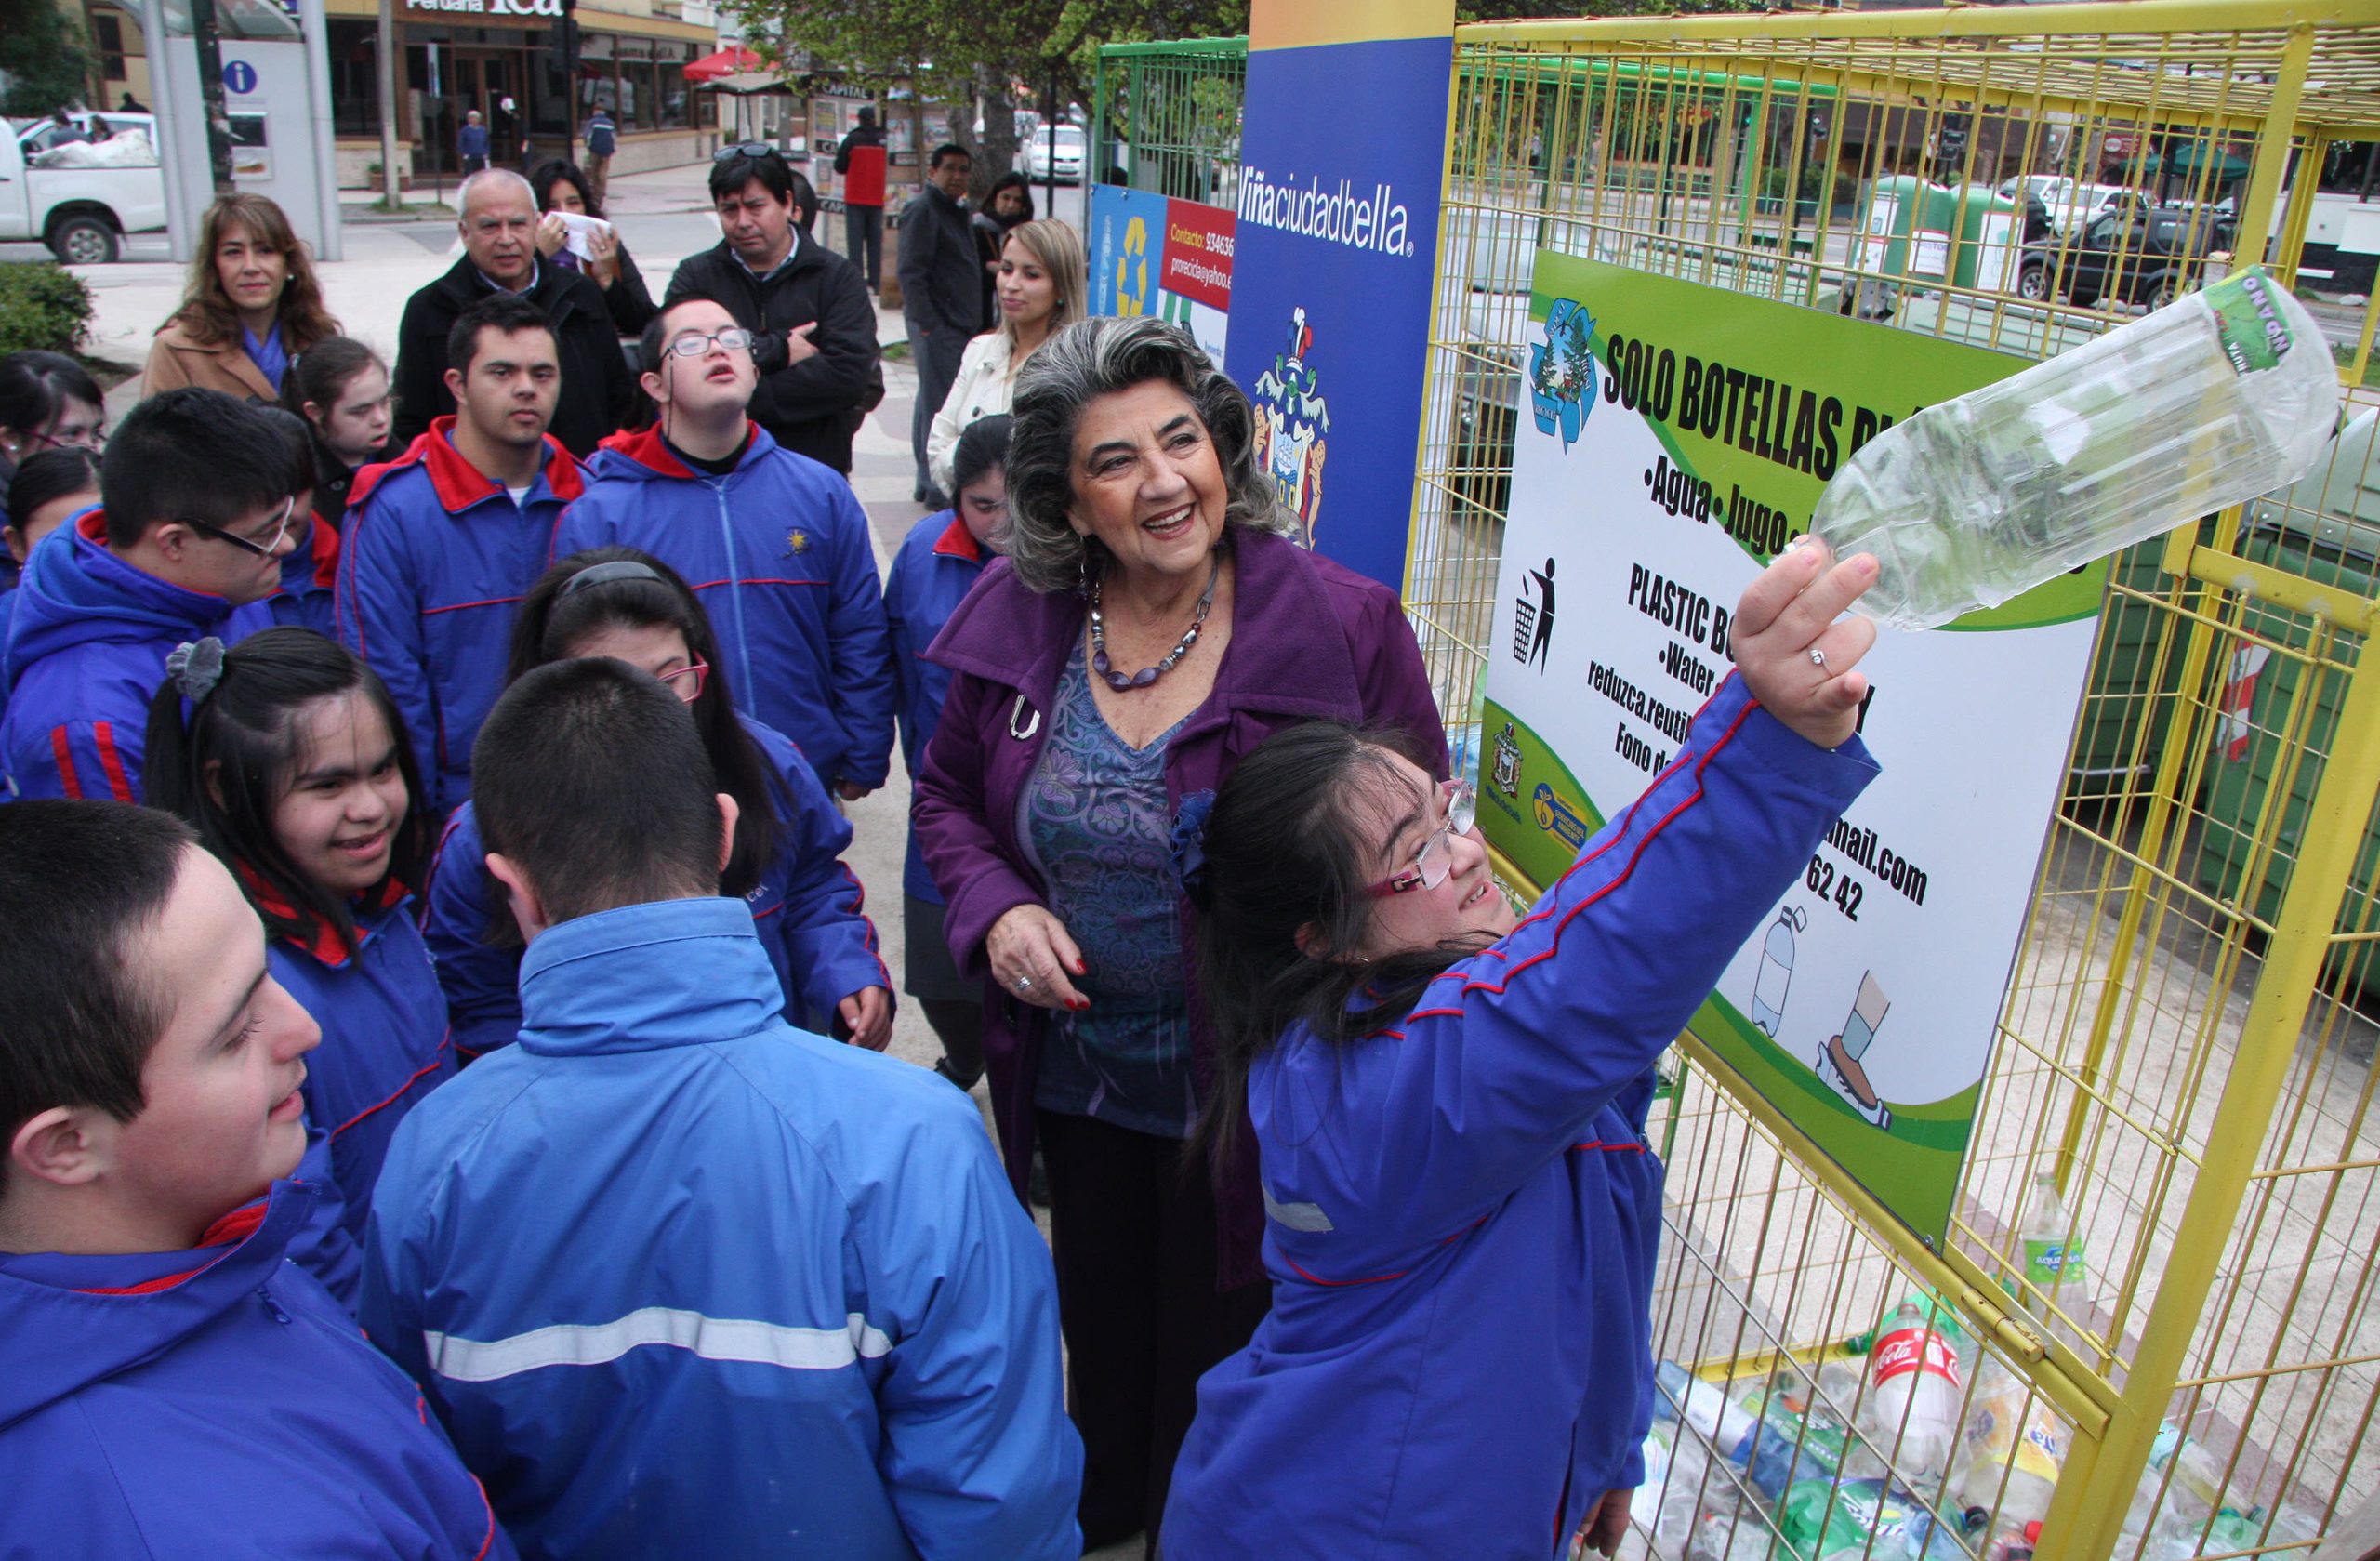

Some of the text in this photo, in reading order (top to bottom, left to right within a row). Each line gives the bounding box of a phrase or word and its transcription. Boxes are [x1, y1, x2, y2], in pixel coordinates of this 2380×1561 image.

[1170, 222, 1235, 257] Contacto: 934636
[1604, 334, 1676, 422] SOLO
[1677, 355, 1843, 482] BOTELLAS
[1650, 455, 1788, 556] Agua Jugo
[1628, 562, 1709, 643] PLASTIC
[1665, 640, 1715, 697] Water
[1615, 721, 1652, 773] Fono
[1806, 853, 1863, 922] 62 42
